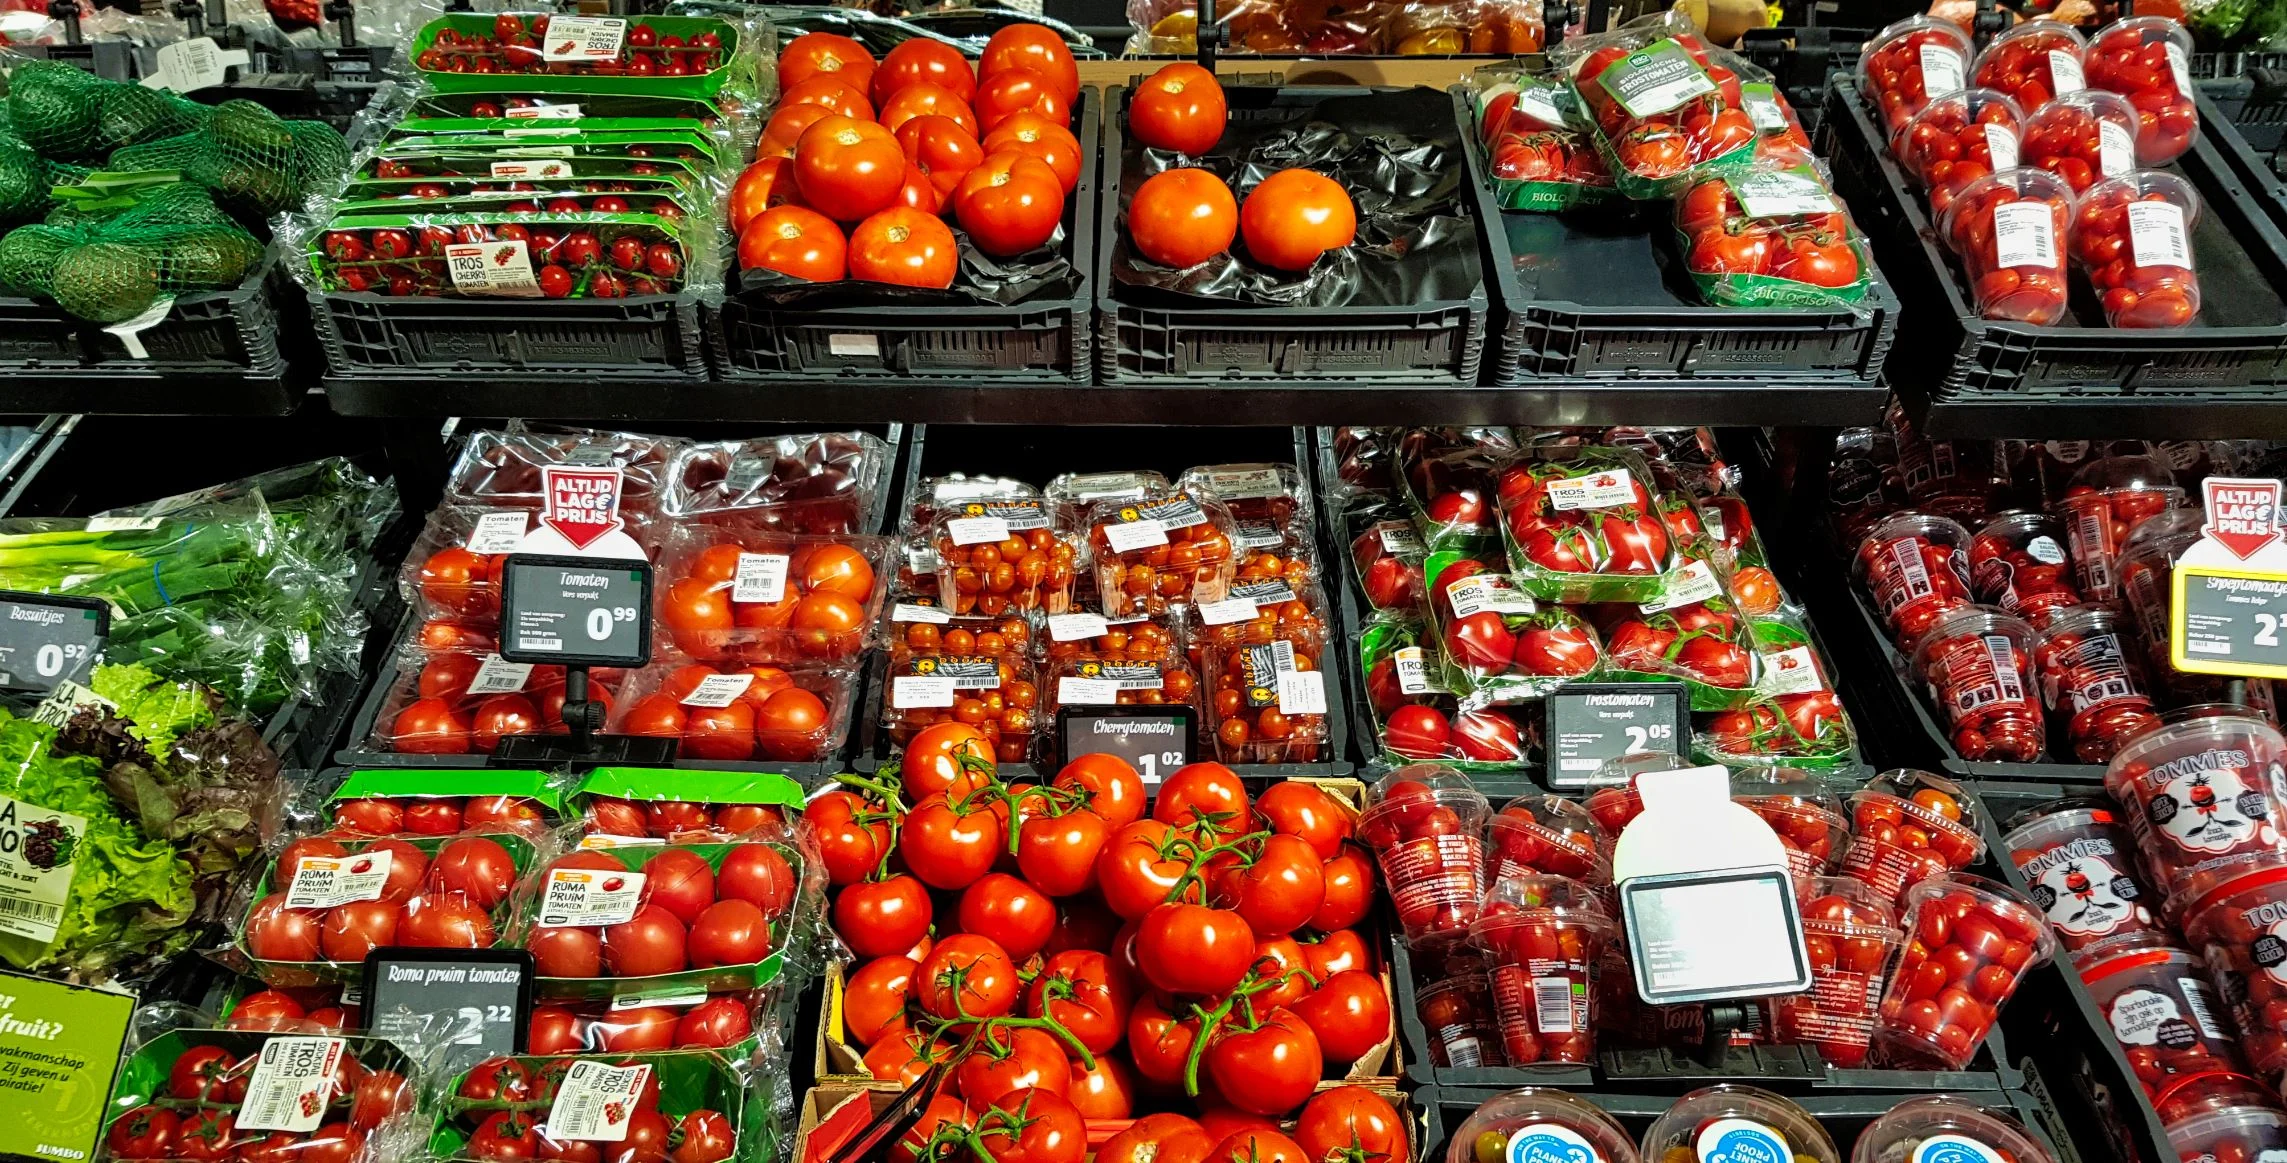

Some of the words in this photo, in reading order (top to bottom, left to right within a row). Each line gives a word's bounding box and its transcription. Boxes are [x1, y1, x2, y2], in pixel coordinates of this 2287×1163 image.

[1618, 59, 1689, 94] TROSTOMATEN
[452, 257, 484, 271] TROS
[455, 270, 487, 281] CHERRY
[555, 477, 613, 494] ALTIJD
[1553, 488, 1585, 496] TROS
[2215, 489, 2272, 505] ALTIJD
[556, 507, 608, 525] PRIJS
[1384, 529, 1412, 538] TROS
[2218, 519, 2269, 536] PRIJS
[560, 571, 609, 590] Tomaten
[562, 590, 576, 599] Vers
[1452, 587, 1483, 600] TROS
[9, 605, 65, 627] Bosuitjes
[586, 607, 614, 641] 0
[613, 606, 637, 622] 99
[2253, 613, 2279, 647] 2
[36, 643, 64, 678] 0
[1400, 660, 1431, 671] TROS
[1585, 694, 1655, 708] Trostomaten
[1093, 718, 1175, 738] Cherrytomaten
[1624, 725, 1649, 755] 2
[1648, 724, 1672, 739] 05
[1138, 753, 1162, 784] 1
[1161, 751, 1184, 766] 02
[297, 879, 333, 887] PRUIM
[300, 870, 334, 880] ROMA
[552, 881, 586, 892] ROMA
[548, 901, 583, 909] TOMATEN
[549, 891, 585, 902] PRUIM
[388, 964, 425, 983] Roma
[424, 966, 466, 987] pruim
[0, 1012, 63, 1041] fruit?
[454, 1006, 484, 1045] 2
[486, 1004, 513, 1023] 22
[0, 1045, 84, 1071] vakmanschap
[283, 1041, 301, 1077] TOMATEN
[294, 1040, 317, 1078] TROS
[309, 1041, 327, 1076] COCKTAIL
[2, 1060, 18, 1076] Zij
[21, 1064, 59, 1083] geven
[60, 1074, 70, 1083] u
[600, 1069, 625, 1093] TROS
[1523, 1137, 1534, 1146] THE
[1950, 1142, 1962, 1150] THE
[1963, 1145, 1978, 1156] WAY
[35, 1143, 85, 1161] JUMBO
[1735, 1142, 1771, 1162] PROOF
